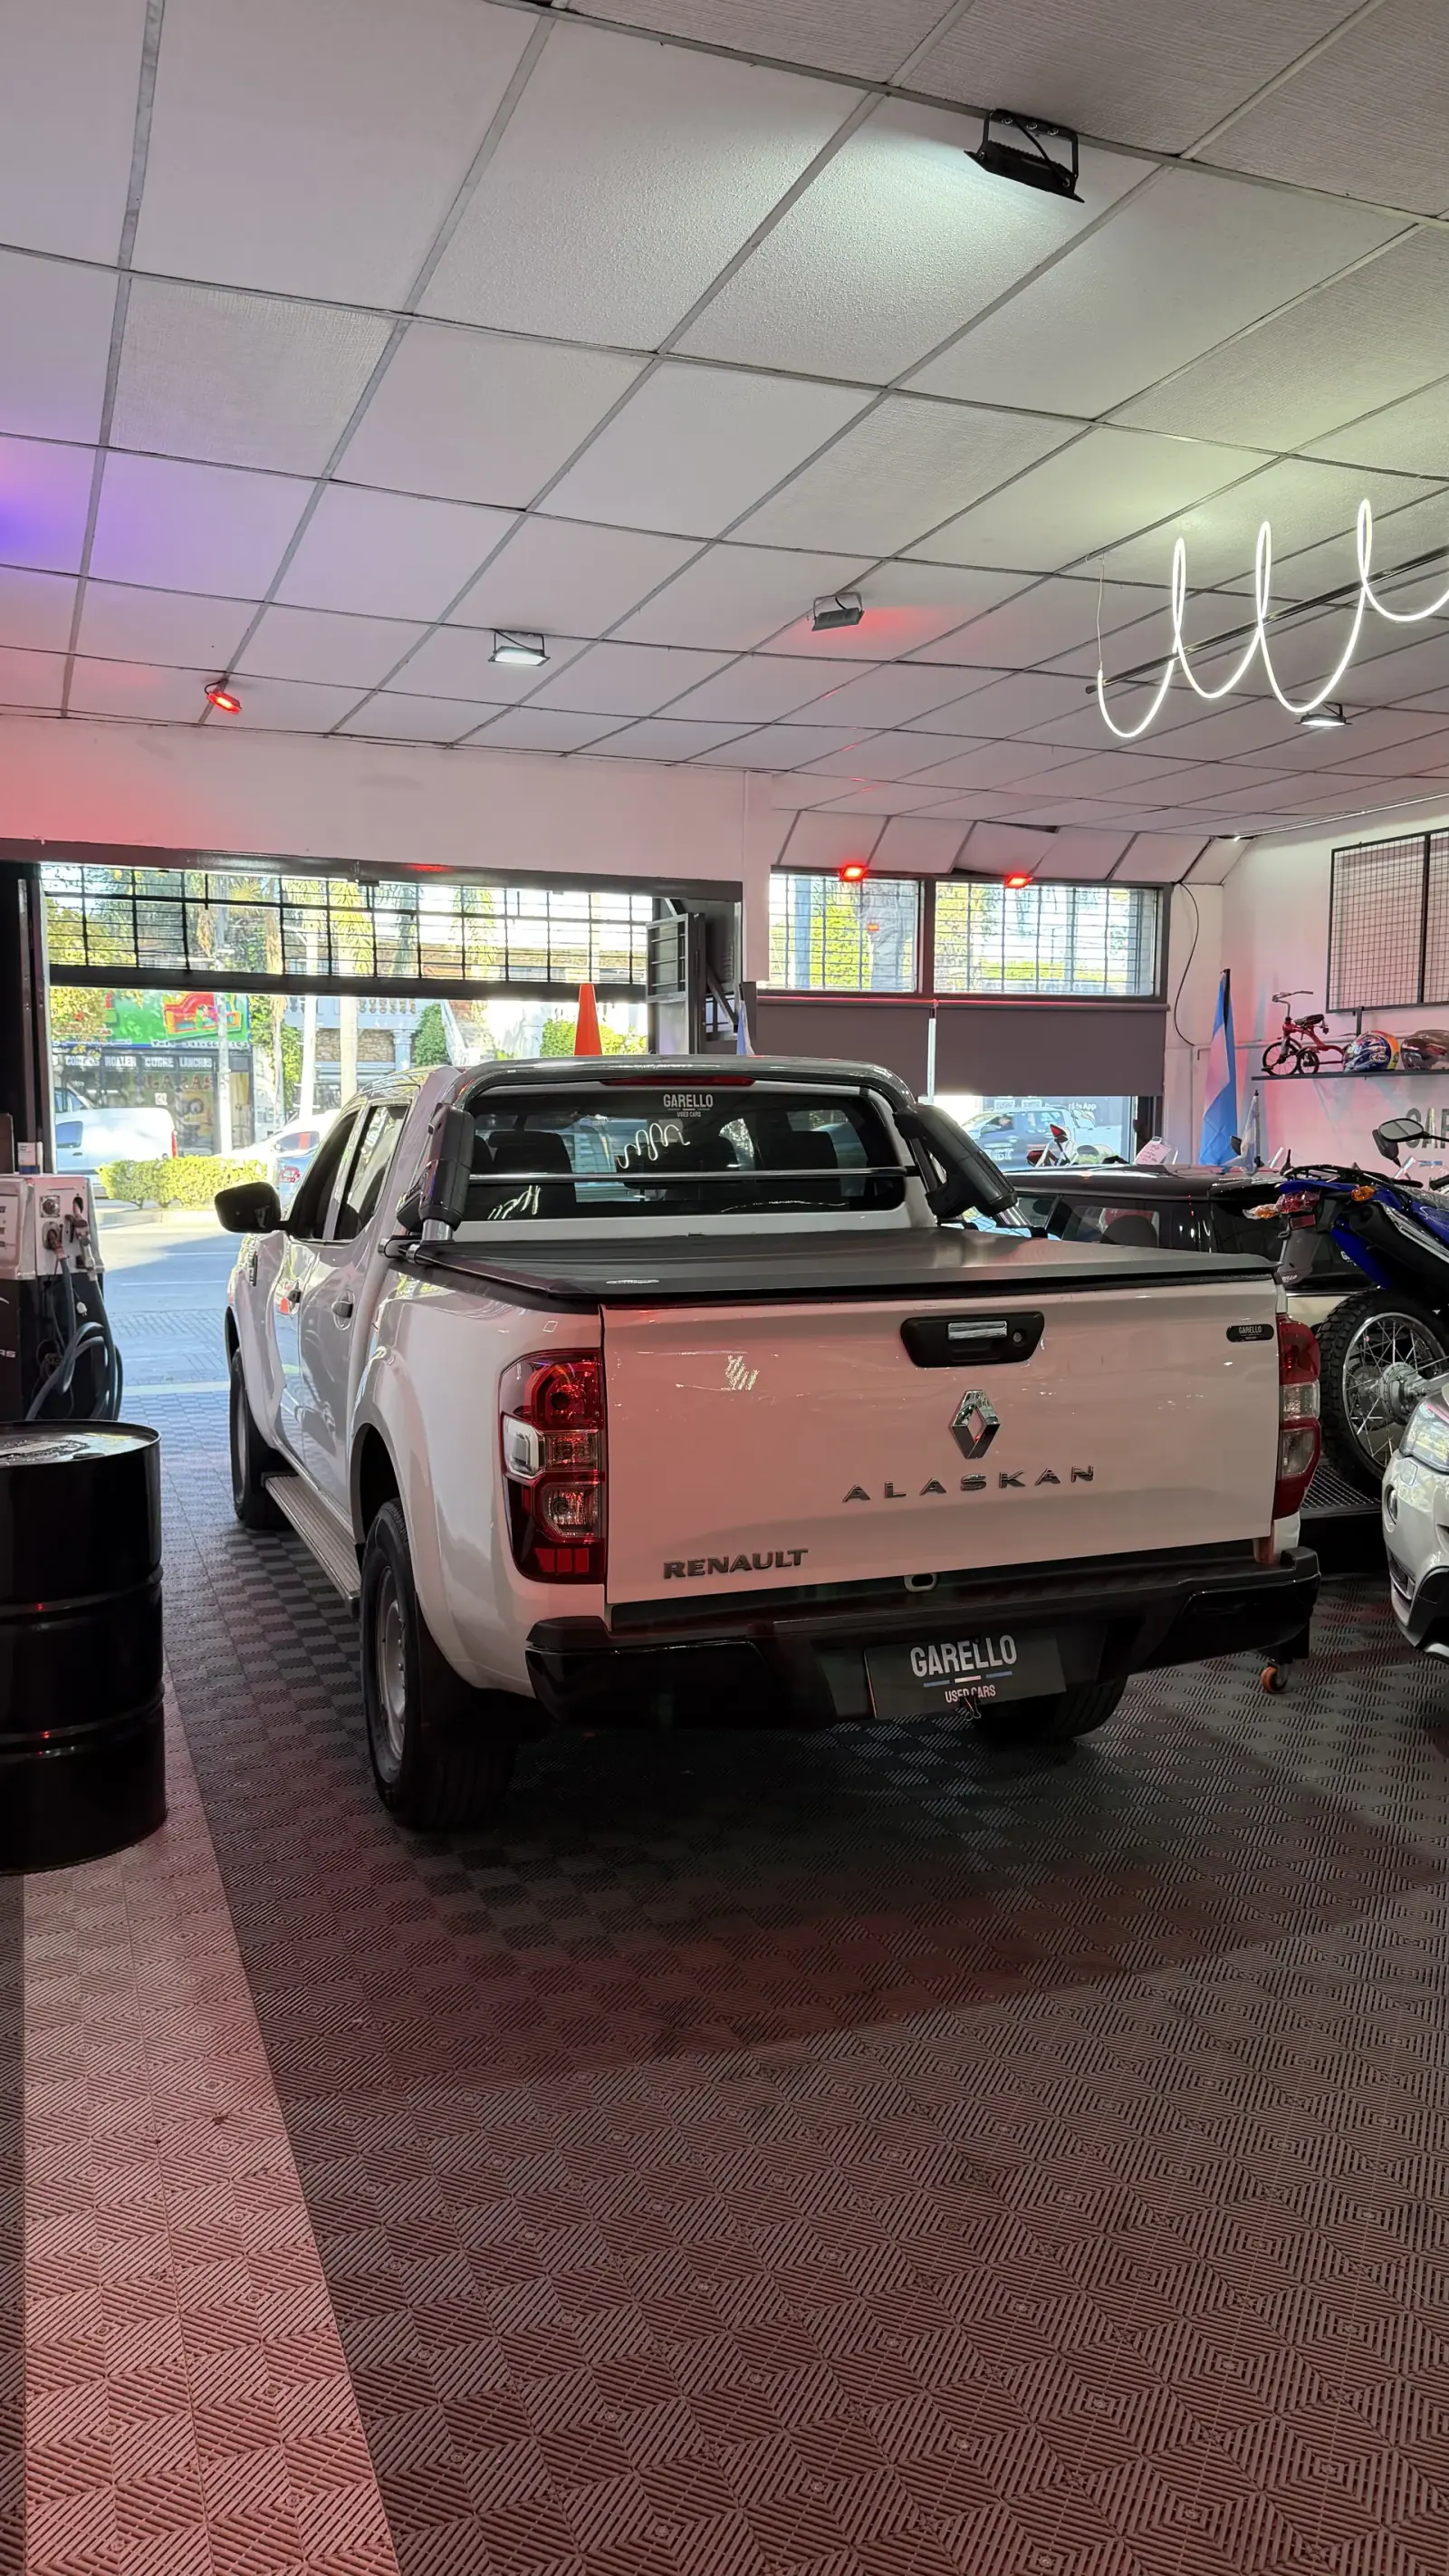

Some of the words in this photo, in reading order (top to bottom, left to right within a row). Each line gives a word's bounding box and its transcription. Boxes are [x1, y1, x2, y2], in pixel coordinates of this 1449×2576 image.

[663, 1093, 714, 1108] GARELLO
[1238, 1325, 1262, 1334] GARELLO
[842, 1465, 1095, 1504] ALASKAN
[663, 1548, 809, 1580] RENAULT
[910, 1634, 1017, 1677] GARELLO
